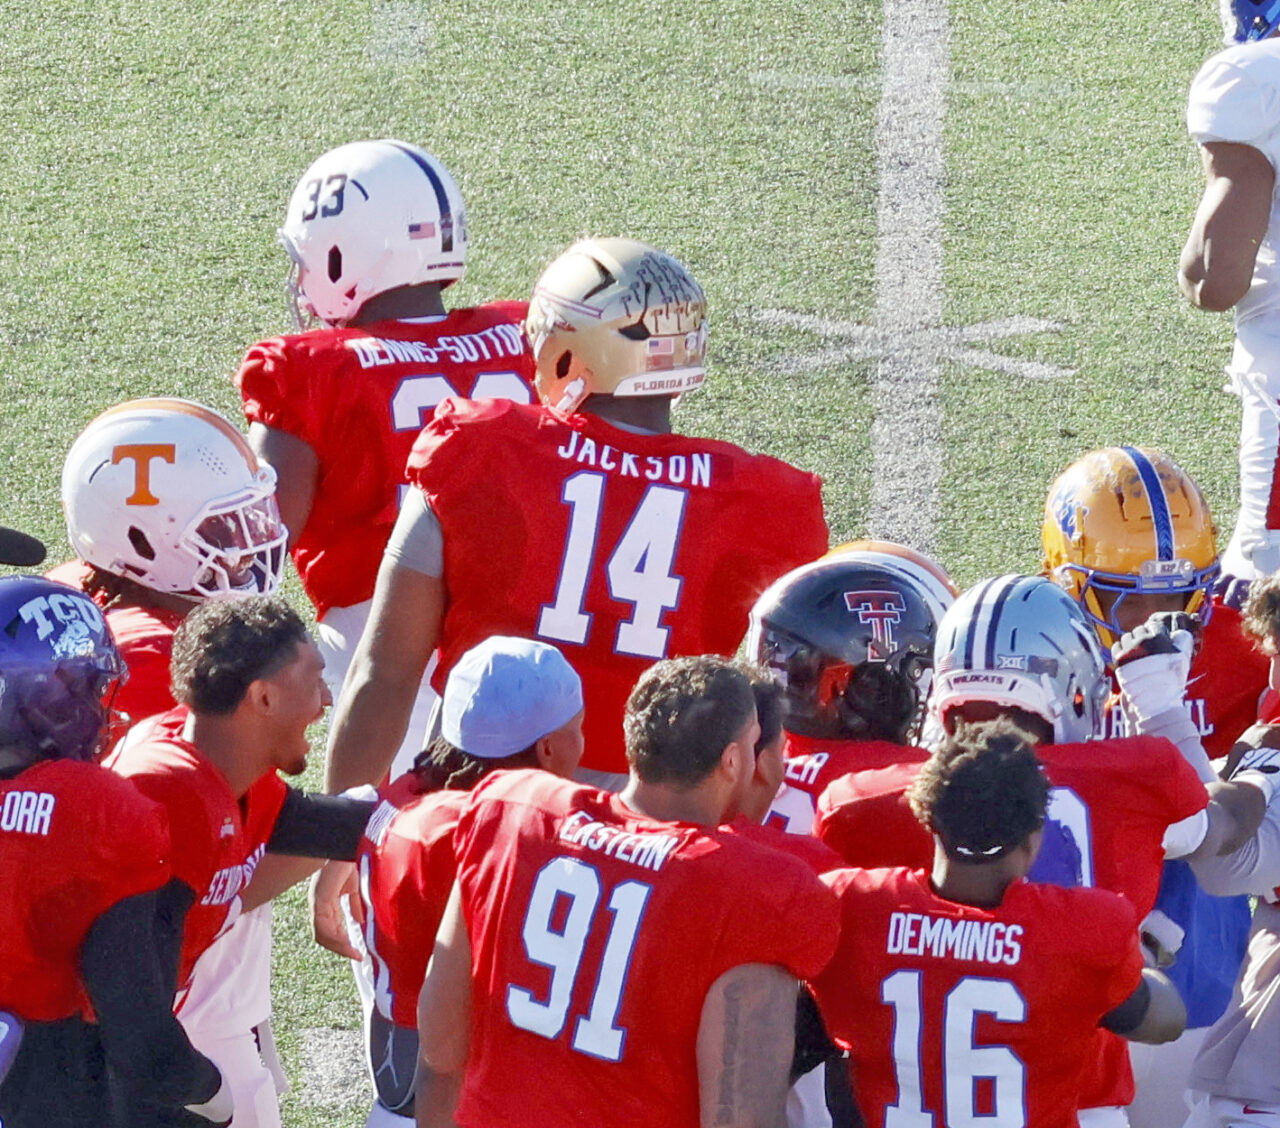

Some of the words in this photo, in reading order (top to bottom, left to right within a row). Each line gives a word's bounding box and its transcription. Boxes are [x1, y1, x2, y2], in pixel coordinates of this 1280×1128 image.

[302, 173, 348, 222] 33
[112, 444, 175, 506] T
[558, 430, 712, 488] JACKSON
[536, 469, 690, 660] 14
[18, 593, 104, 641] TCU
[0, 790, 56, 836] ORR
[559, 810, 679, 872] EASTERN
[506, 854, 653, 1062] 91
[886, 911, 1024, 966] DEMMINGS
